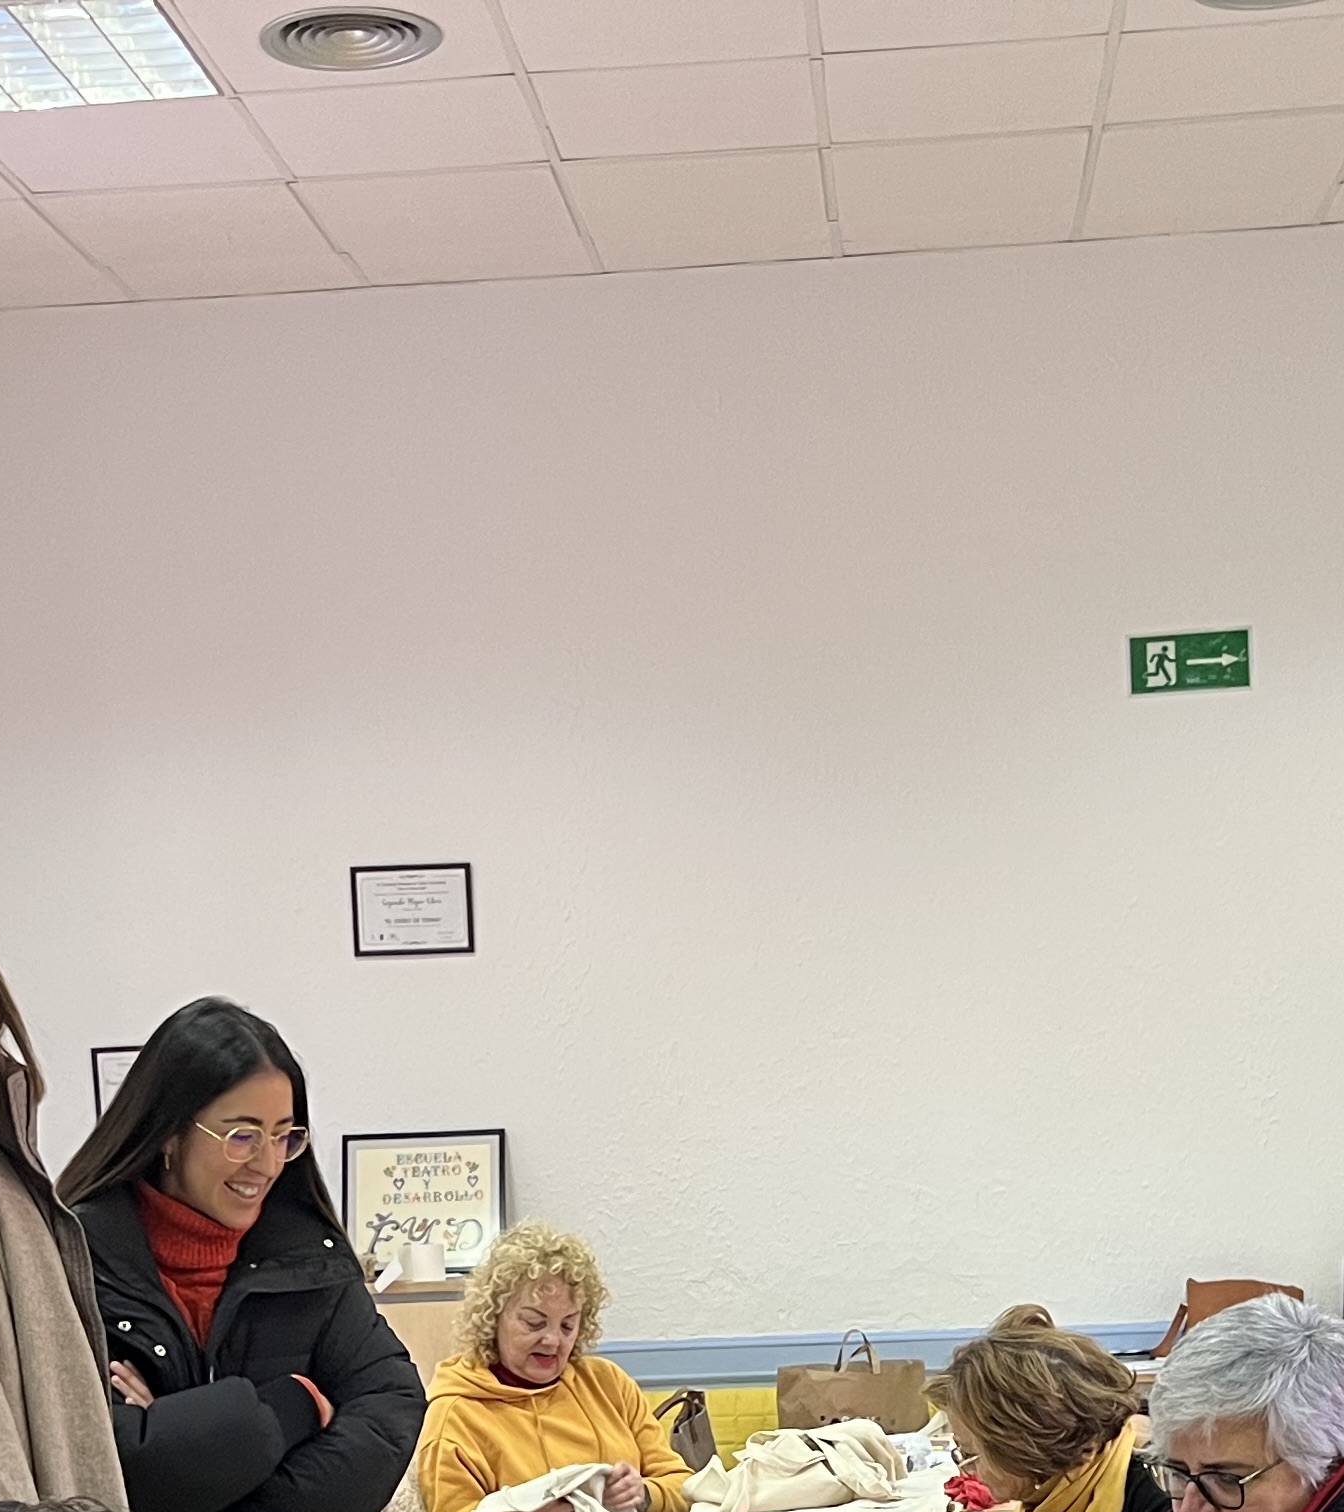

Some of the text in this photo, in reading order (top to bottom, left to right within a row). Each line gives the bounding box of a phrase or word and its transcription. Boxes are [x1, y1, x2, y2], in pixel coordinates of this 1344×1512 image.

[396, 1152, 462, 1165] ESCUELA
[401, 1164, 462, 1178] TEATRO
[422, 1179, 430, 1190] Y
[382, 1189, 484, 1205] DESARROLLO
